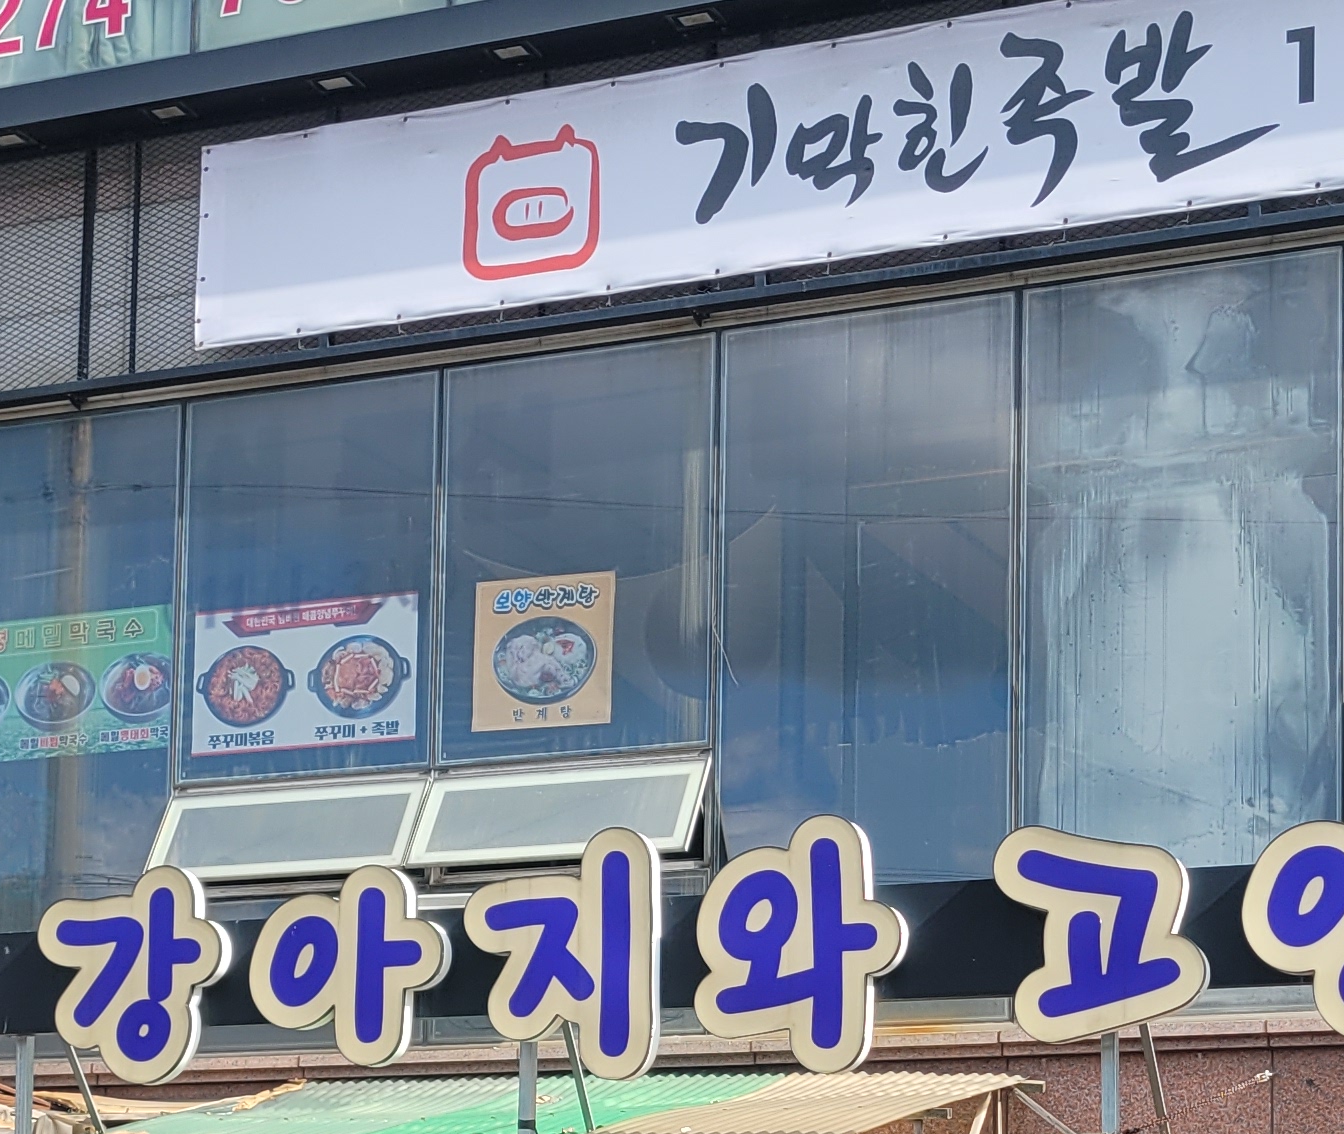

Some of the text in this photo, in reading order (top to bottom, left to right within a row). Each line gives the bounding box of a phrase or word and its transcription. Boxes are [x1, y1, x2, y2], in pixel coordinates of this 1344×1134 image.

[513, 705, 572, 721] 반계탕
[208, 730, 275, 749] 쭈꾸미볶음
[314, 723, 356, 740] 쭈꾸미
[371, 720, 400, 736] 족발
[50, 831, 885, 1068] 강아지와
